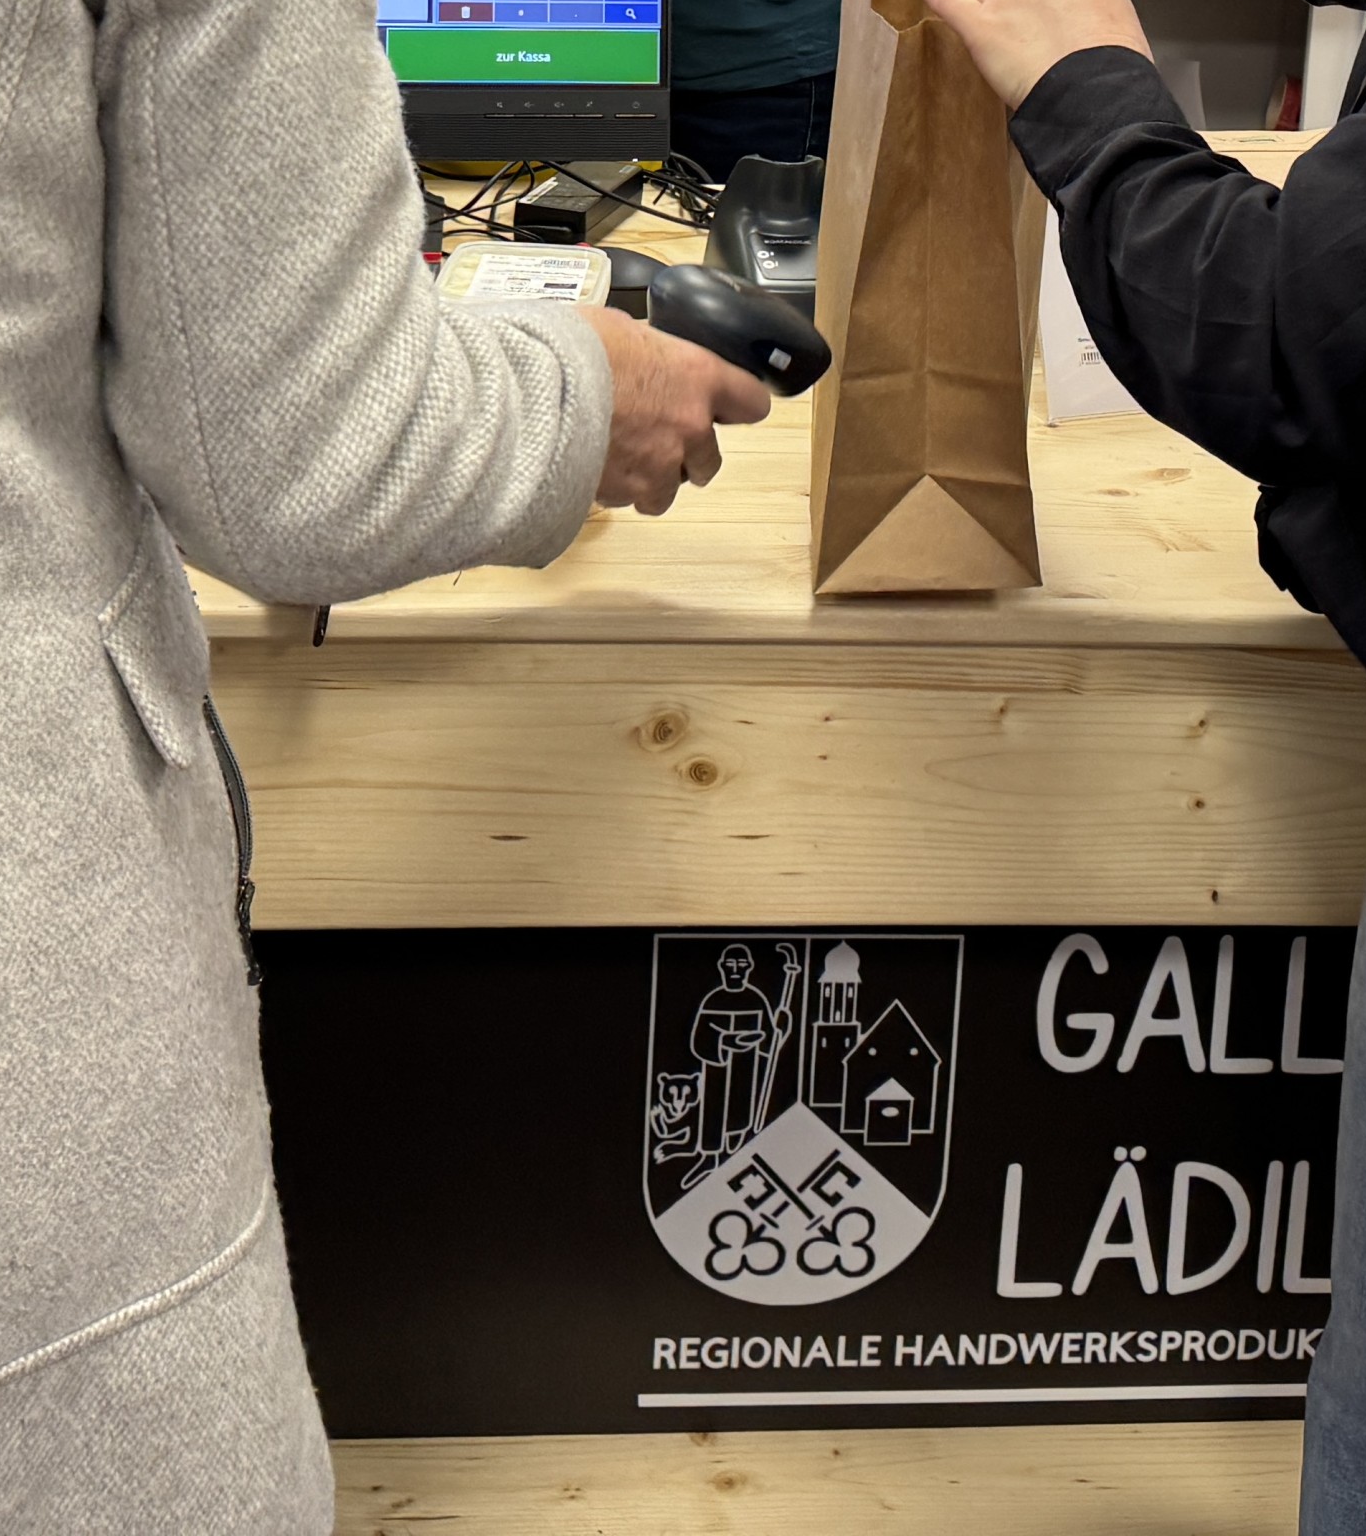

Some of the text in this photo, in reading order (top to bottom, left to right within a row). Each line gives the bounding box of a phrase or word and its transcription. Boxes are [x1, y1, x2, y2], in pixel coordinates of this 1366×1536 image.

[496, 50, 551, 62] zur Kassa
[1036, 932, 1344, 1075] GALL
[995, 1145, 1332, 1298] LÄDIL
[652, 1328, 1327, 1370] REGIONALE HANDWERKSPRODUK
